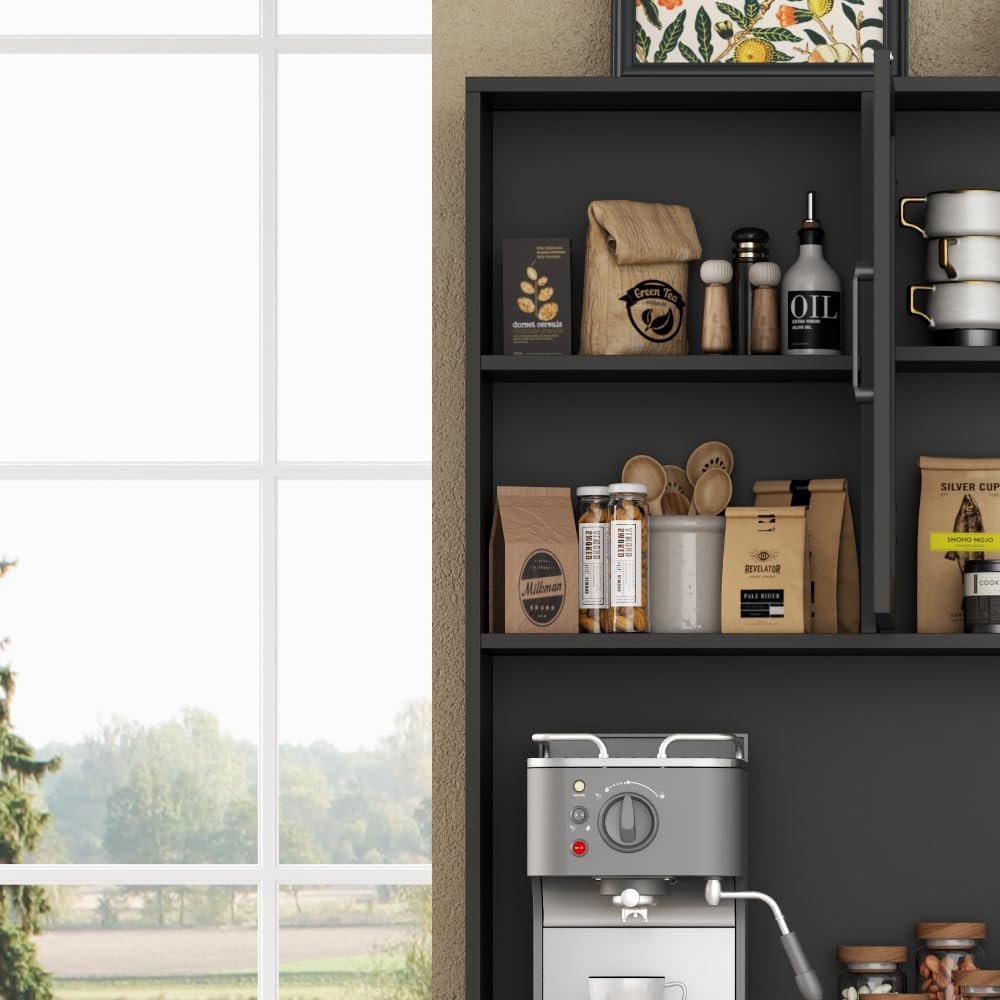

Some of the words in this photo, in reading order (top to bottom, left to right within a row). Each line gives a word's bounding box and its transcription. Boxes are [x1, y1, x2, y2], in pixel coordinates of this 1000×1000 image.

[634, 287, 661, 299] Green
[663, 287, 678, 303] Tea
[790, 294, 838, 319] OIL
[940, 482, 976, 492] SILVER
[979, 482, 1000, 492] CUP
[744, 564, 781, 575] REVELATOR
[521, 580, 562, 597] Milkman
